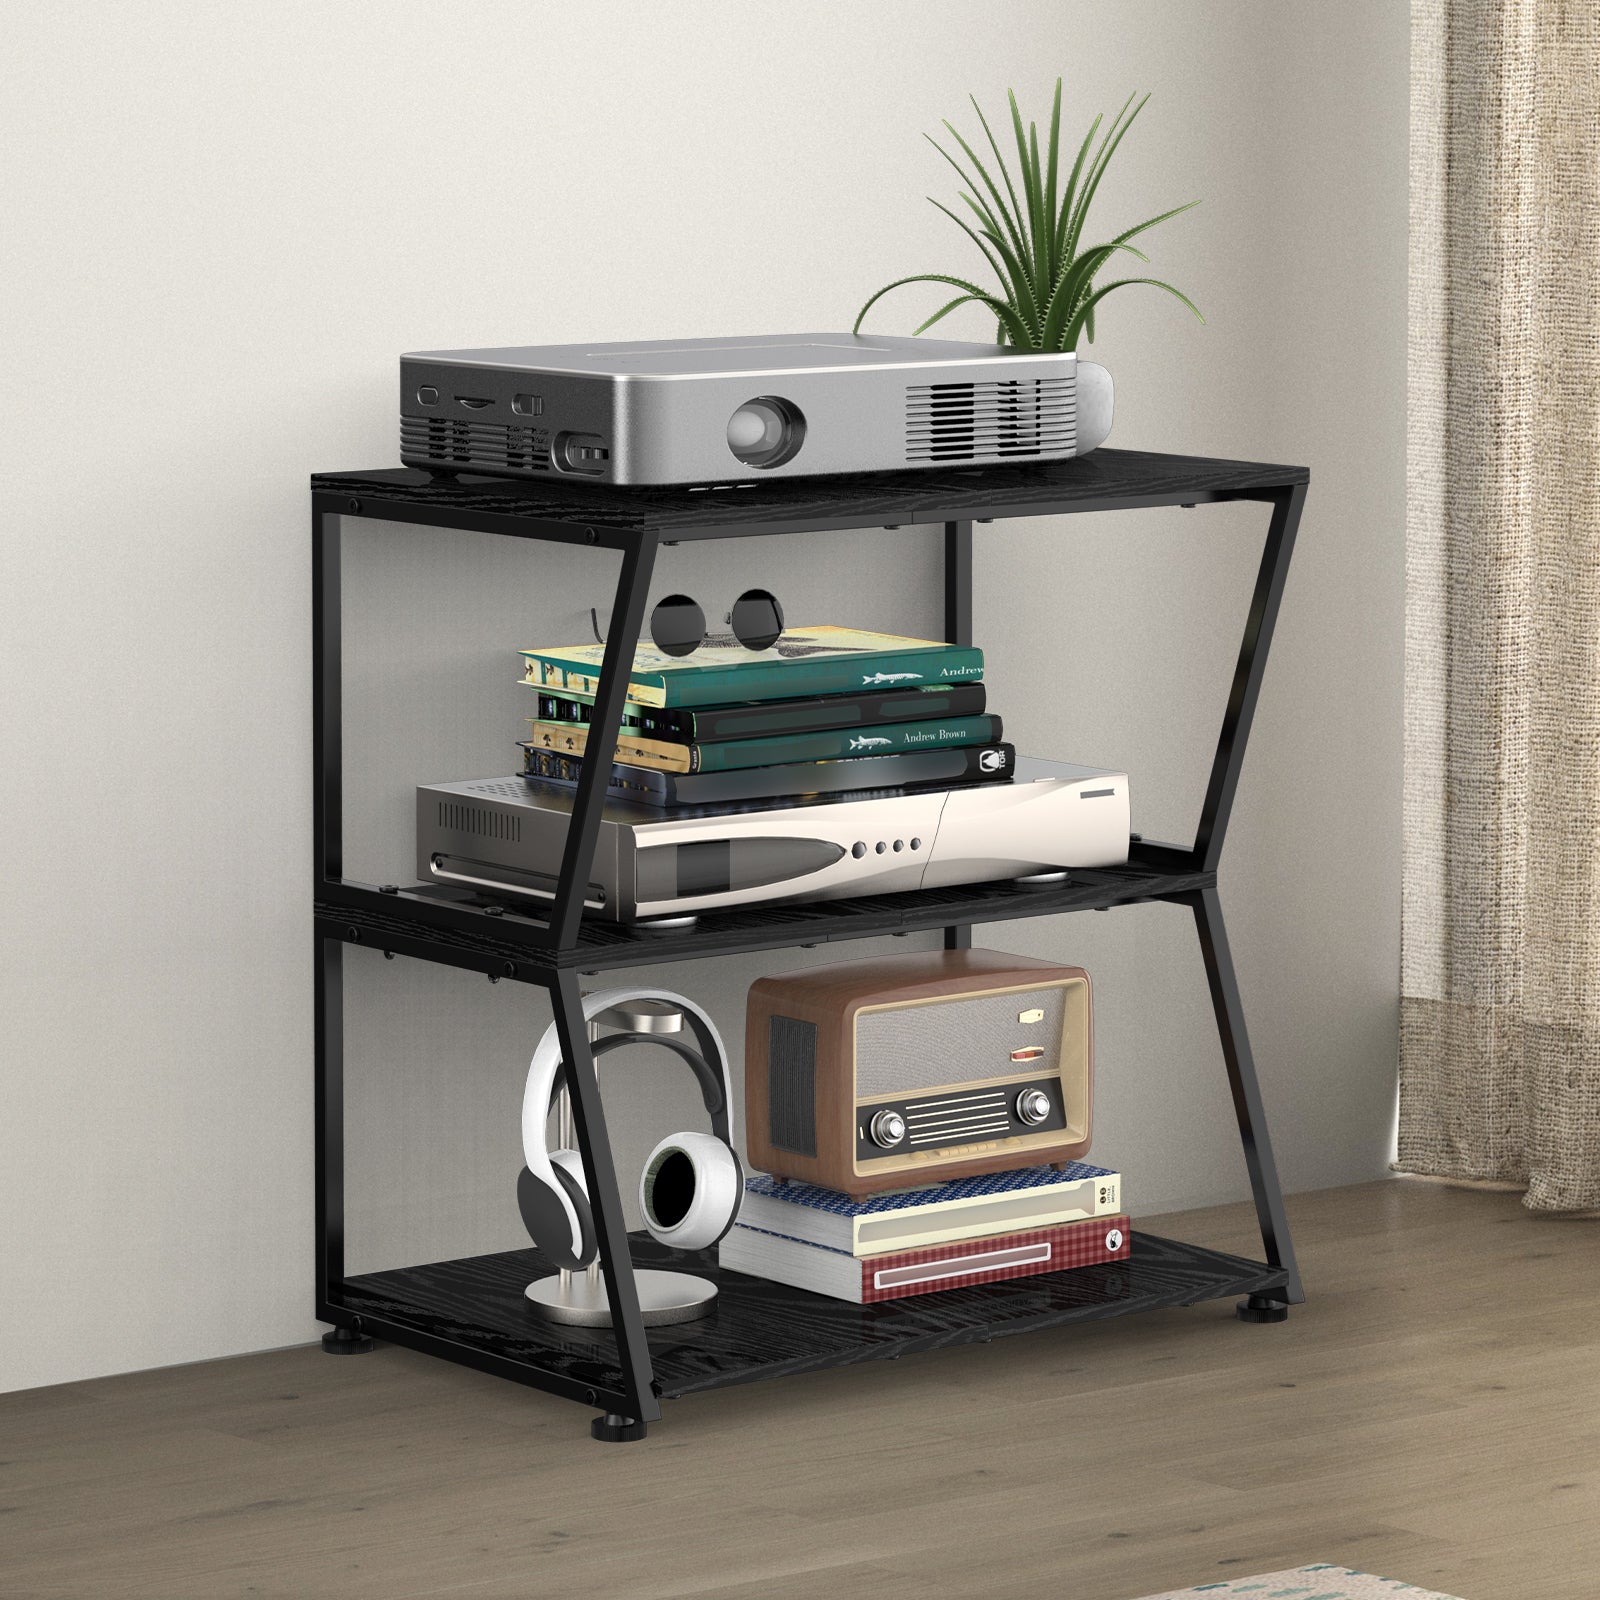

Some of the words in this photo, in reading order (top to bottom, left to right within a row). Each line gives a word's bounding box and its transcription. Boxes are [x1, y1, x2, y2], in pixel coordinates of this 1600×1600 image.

[904, 731, 936, 743] Andrew
[939, 729, 966, 740] Brown
[998, 750, 1006, 769] TOR
